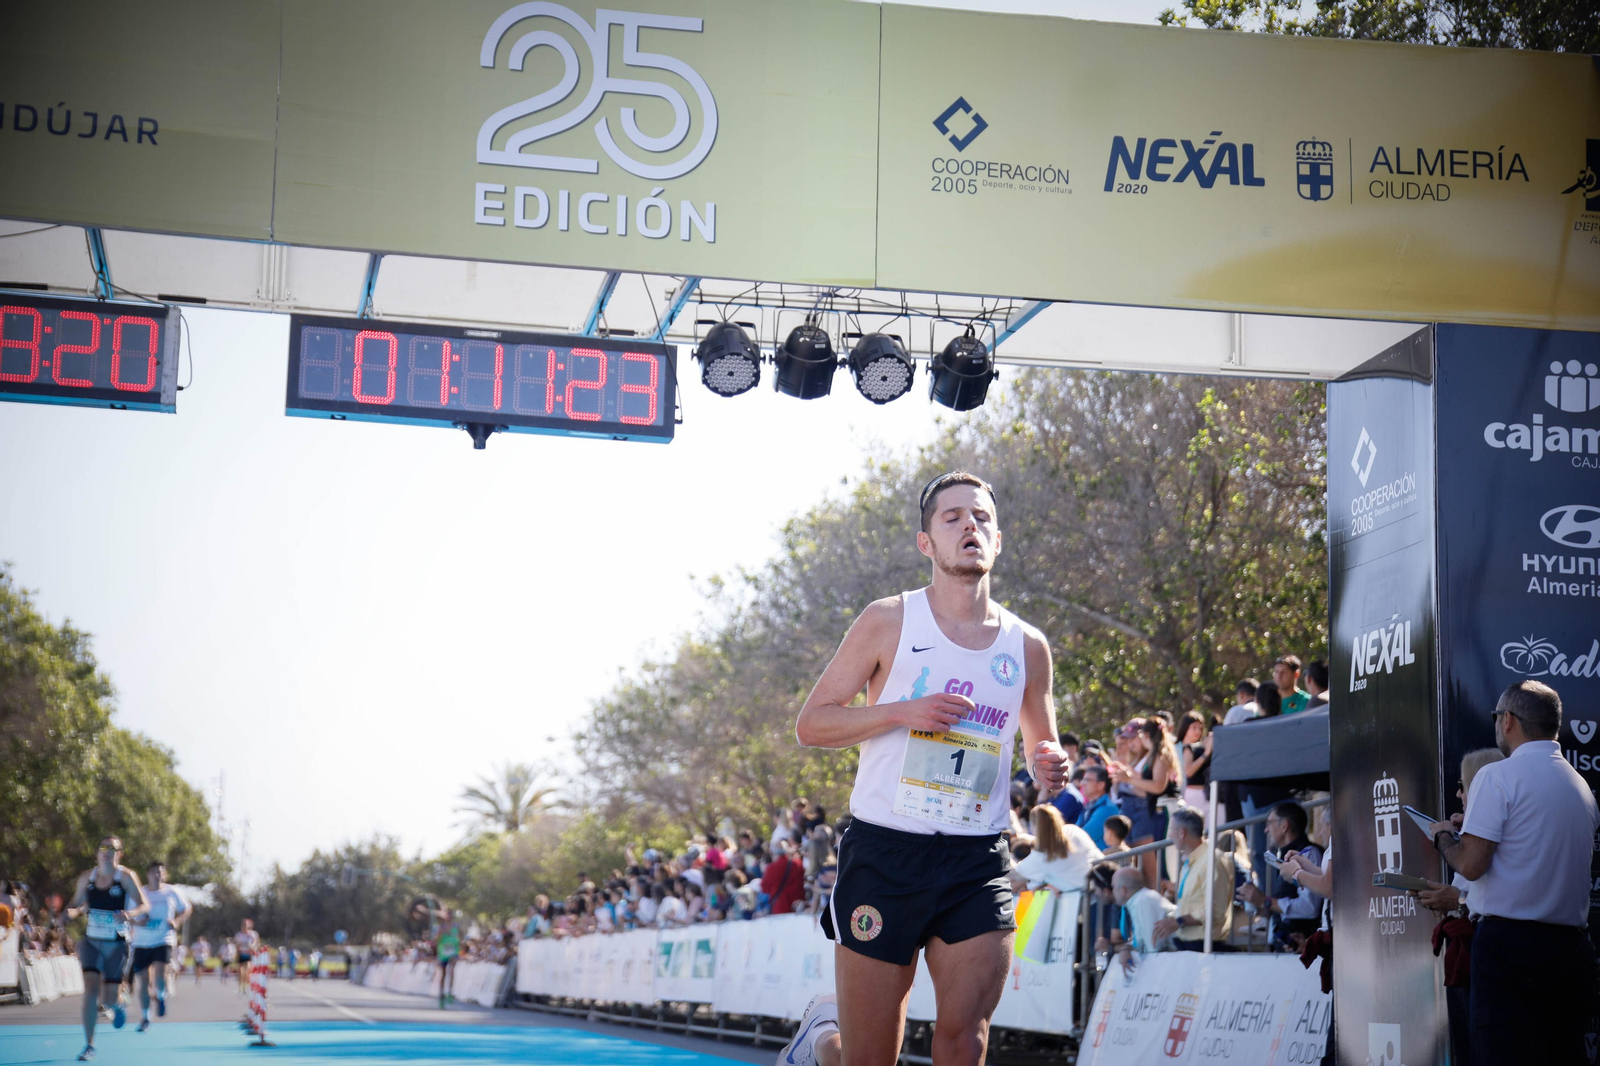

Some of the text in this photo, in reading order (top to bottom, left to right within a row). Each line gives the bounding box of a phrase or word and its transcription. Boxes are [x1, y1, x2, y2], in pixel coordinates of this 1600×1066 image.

[476, 1, 719, 181] 25
[0, 101, 160, 146] DÚJAR
[931, 157, 1070, 185] COOPERACIÓN
[1369, 144, 1530, 182] ALMERÍA
[931, 176, 978, 195] 2005
[1018, 184, 1036, 192] ocio
[1045, 186, 1073, 195] cultura
[1116, 183, 1149, 195] 2020
[1369, 179, 1451, 202] CIUDAD
[474, 182, 717, 244] EDICIÓN
[1574, 220, 1600, 232] DEP
[1571, 456, 1600, 469] CAJ
[1351, 472, 1416, 515] COOPERACIÓN
[1351, 512, 1374, 537] 2005
[1522, 553, 1600, 576] HYUN
[944, 678, 974, 698] GO
[964, 740, 978, 748] 2024
[950, 749, 966, 775] 1
[934, 773, 972, 787] ALBERTO
[1368, 890, 1417, 918] ALMERÍA
[1380, 920, 1406, 935] CIUDAD
[1205, 994, 1276, 1034] ALMERÍA
[1286, 1041, 1324, 1064] CIUDA
